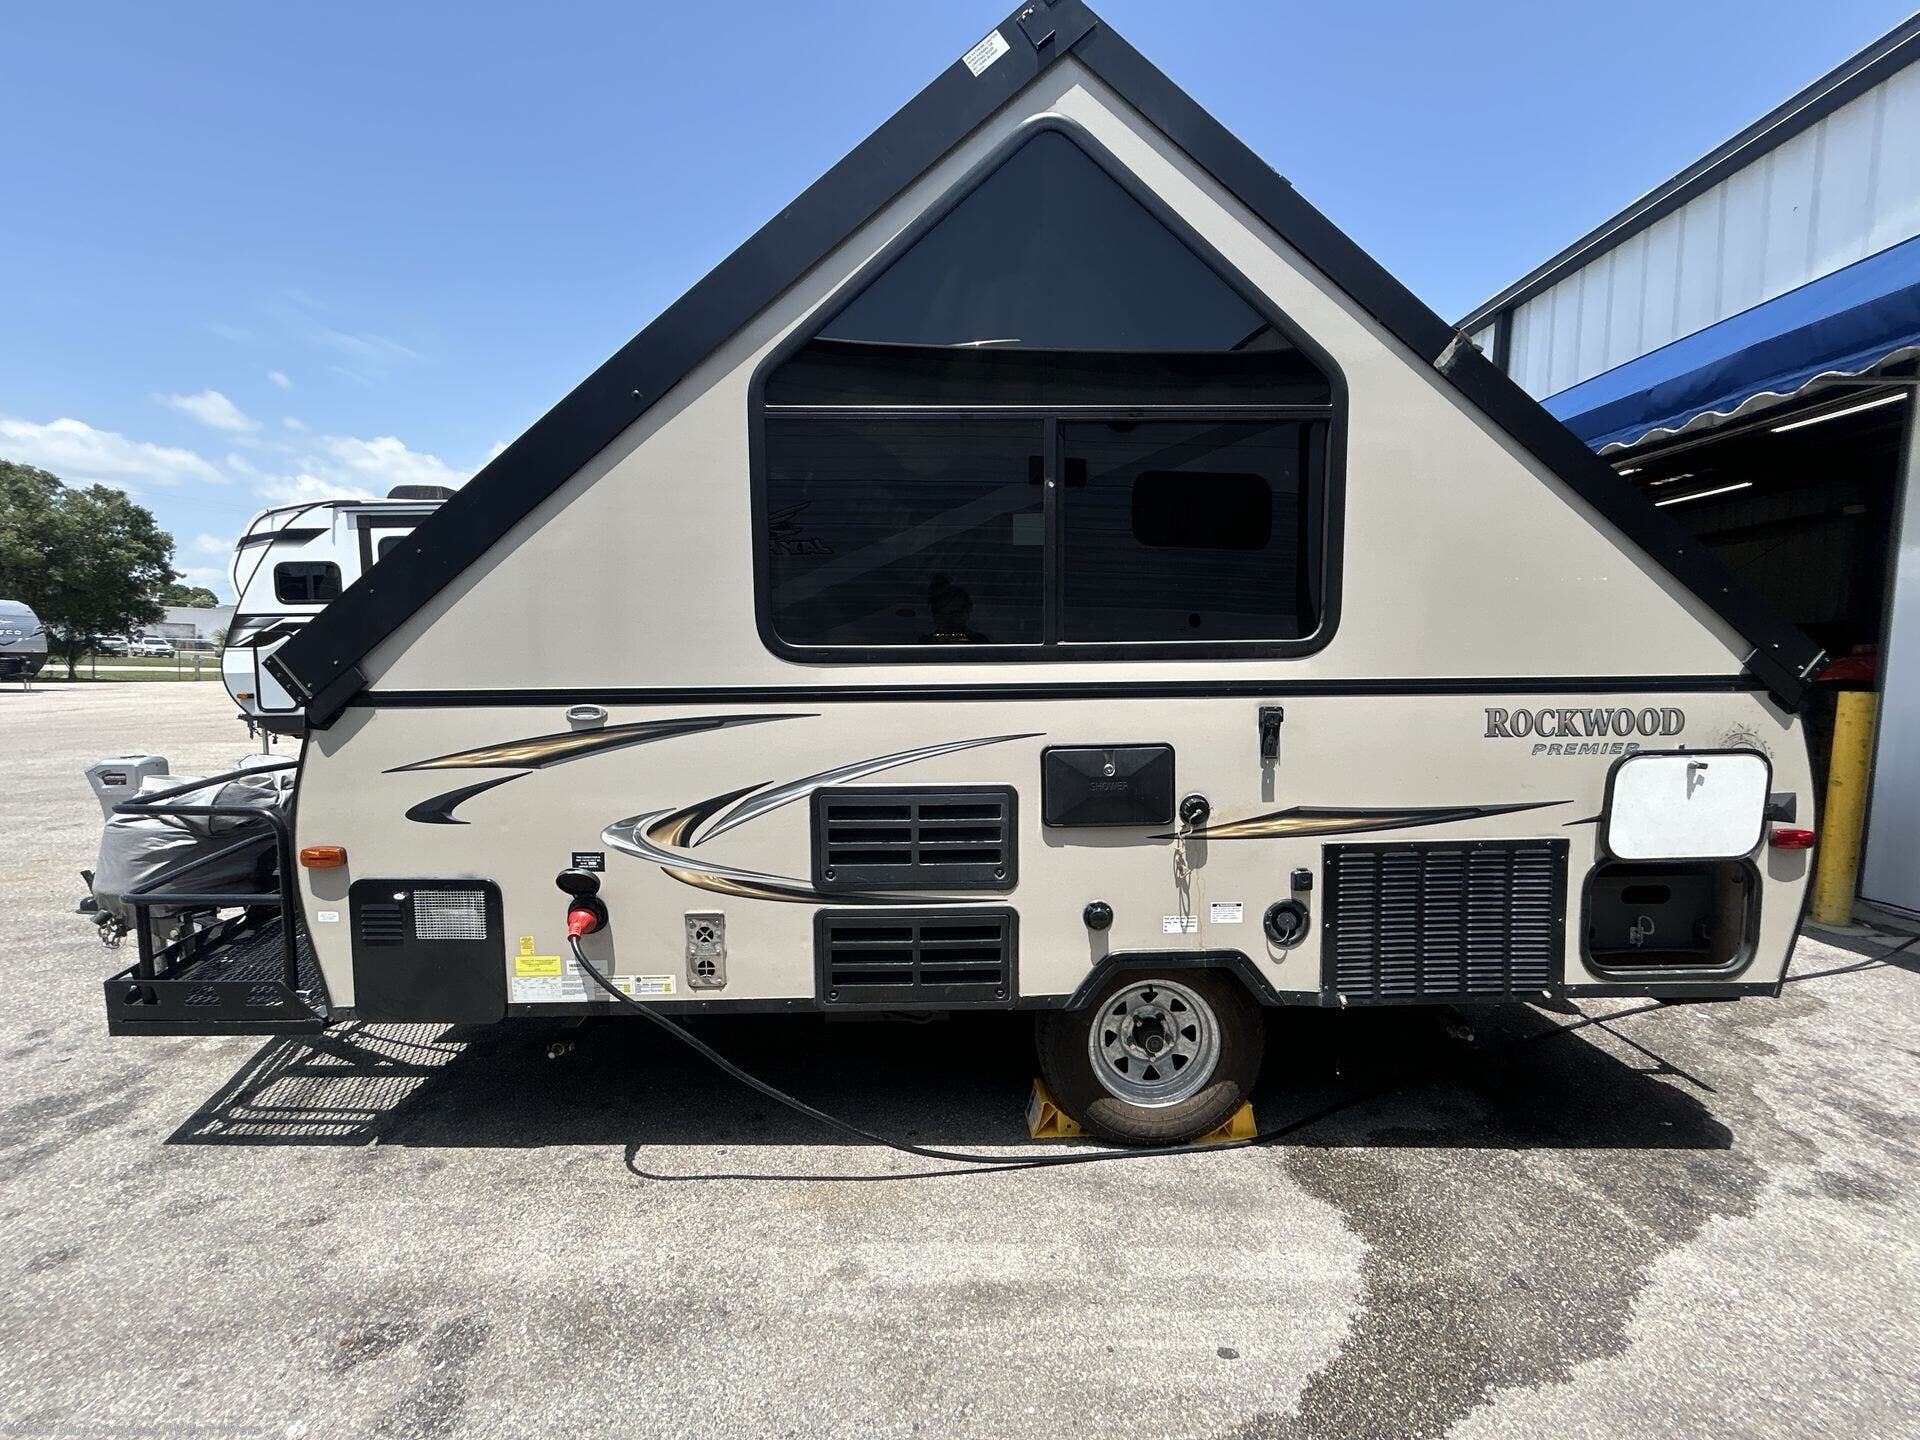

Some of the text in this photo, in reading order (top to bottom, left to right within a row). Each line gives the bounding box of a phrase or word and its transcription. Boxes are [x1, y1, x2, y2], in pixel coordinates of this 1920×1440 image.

[1484, 707, 1686, 738] ROCKWOOD
[1531, 742, 1640, 756] PREMIER
[1089, 781, 1129, 792] SHOWER
